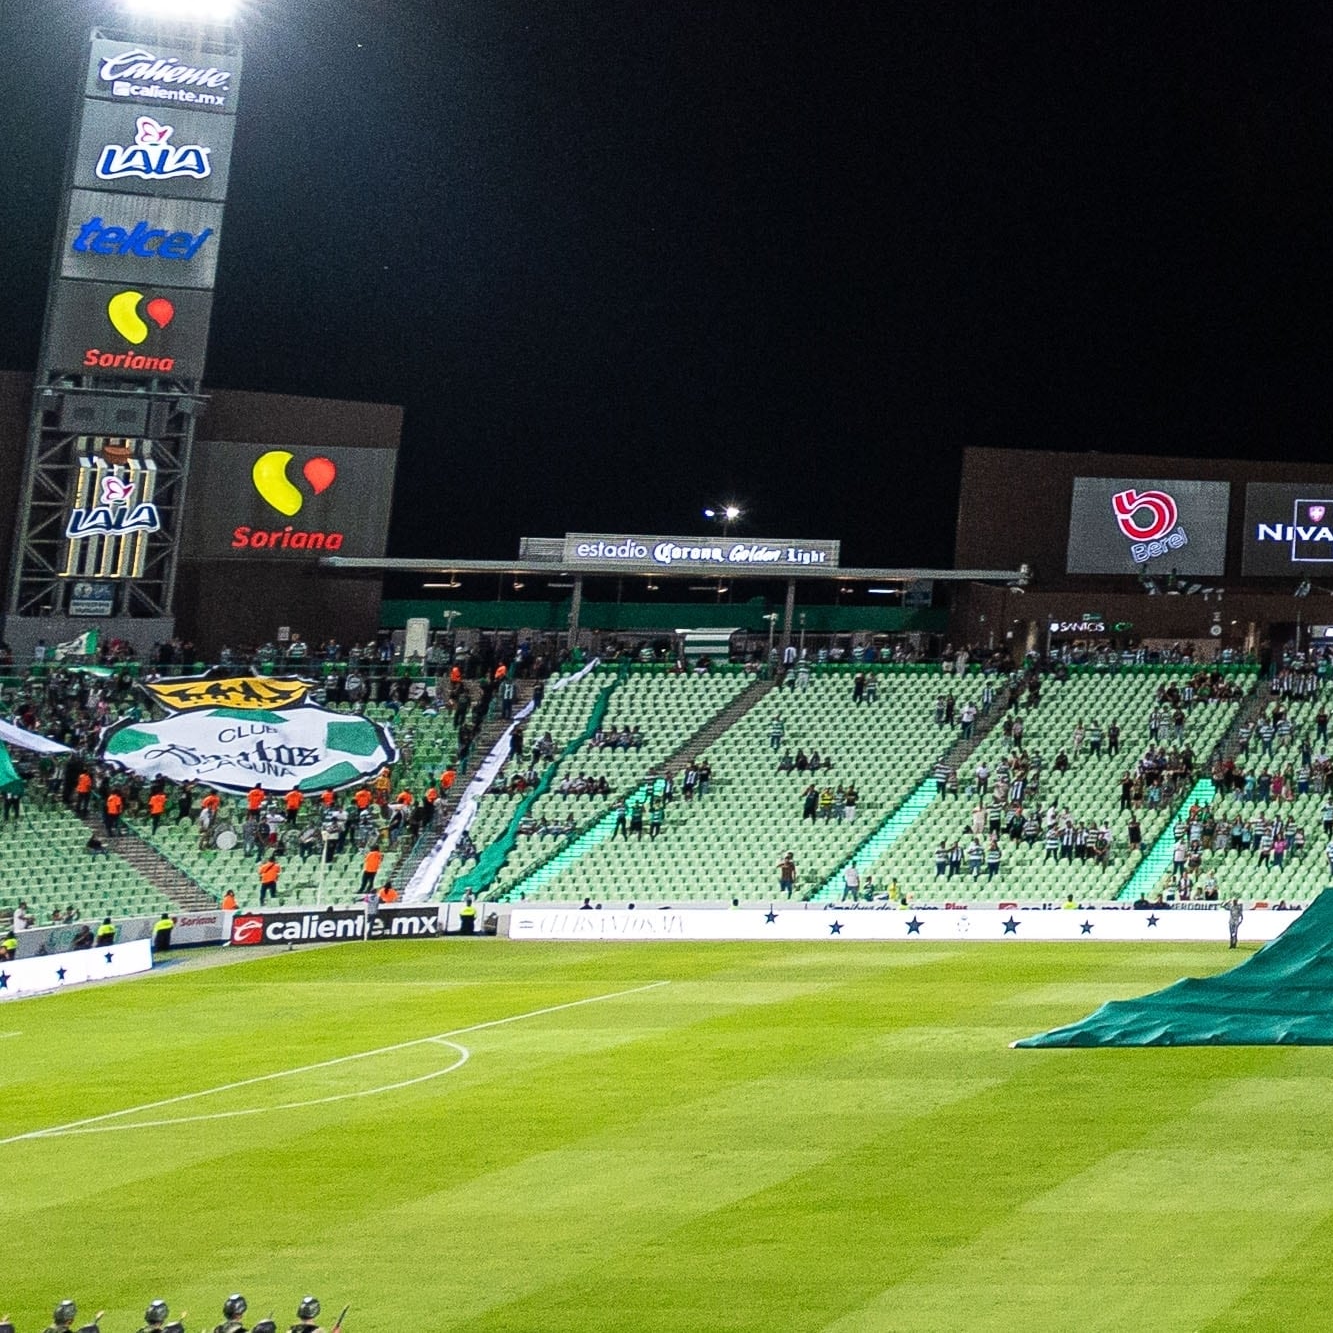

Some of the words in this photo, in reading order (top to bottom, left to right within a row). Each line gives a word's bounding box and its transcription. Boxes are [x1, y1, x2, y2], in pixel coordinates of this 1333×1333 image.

[101, 49, 230, 88] Caliente
[130, 84, 225, 106] caliente.mx
[96, 145, 211, 180] LALA
[71, 216, 214, 262] telcel
[84, 348, 175, 372] Soriana
[66, 503, 160, 539] LALA
[231, 525, 344, 550] Soriana
[1130, 526, 1189, 564] Berel
[577, 539, 648, 558] estadio
[653, 542, 726, 565] Corona
[728, 544, 783, 563] Golden
[786, 547, 827, 565] Light
[1059, 621, 1105, 633] SANTOS
[218, 723, 279, 744] CLUB
